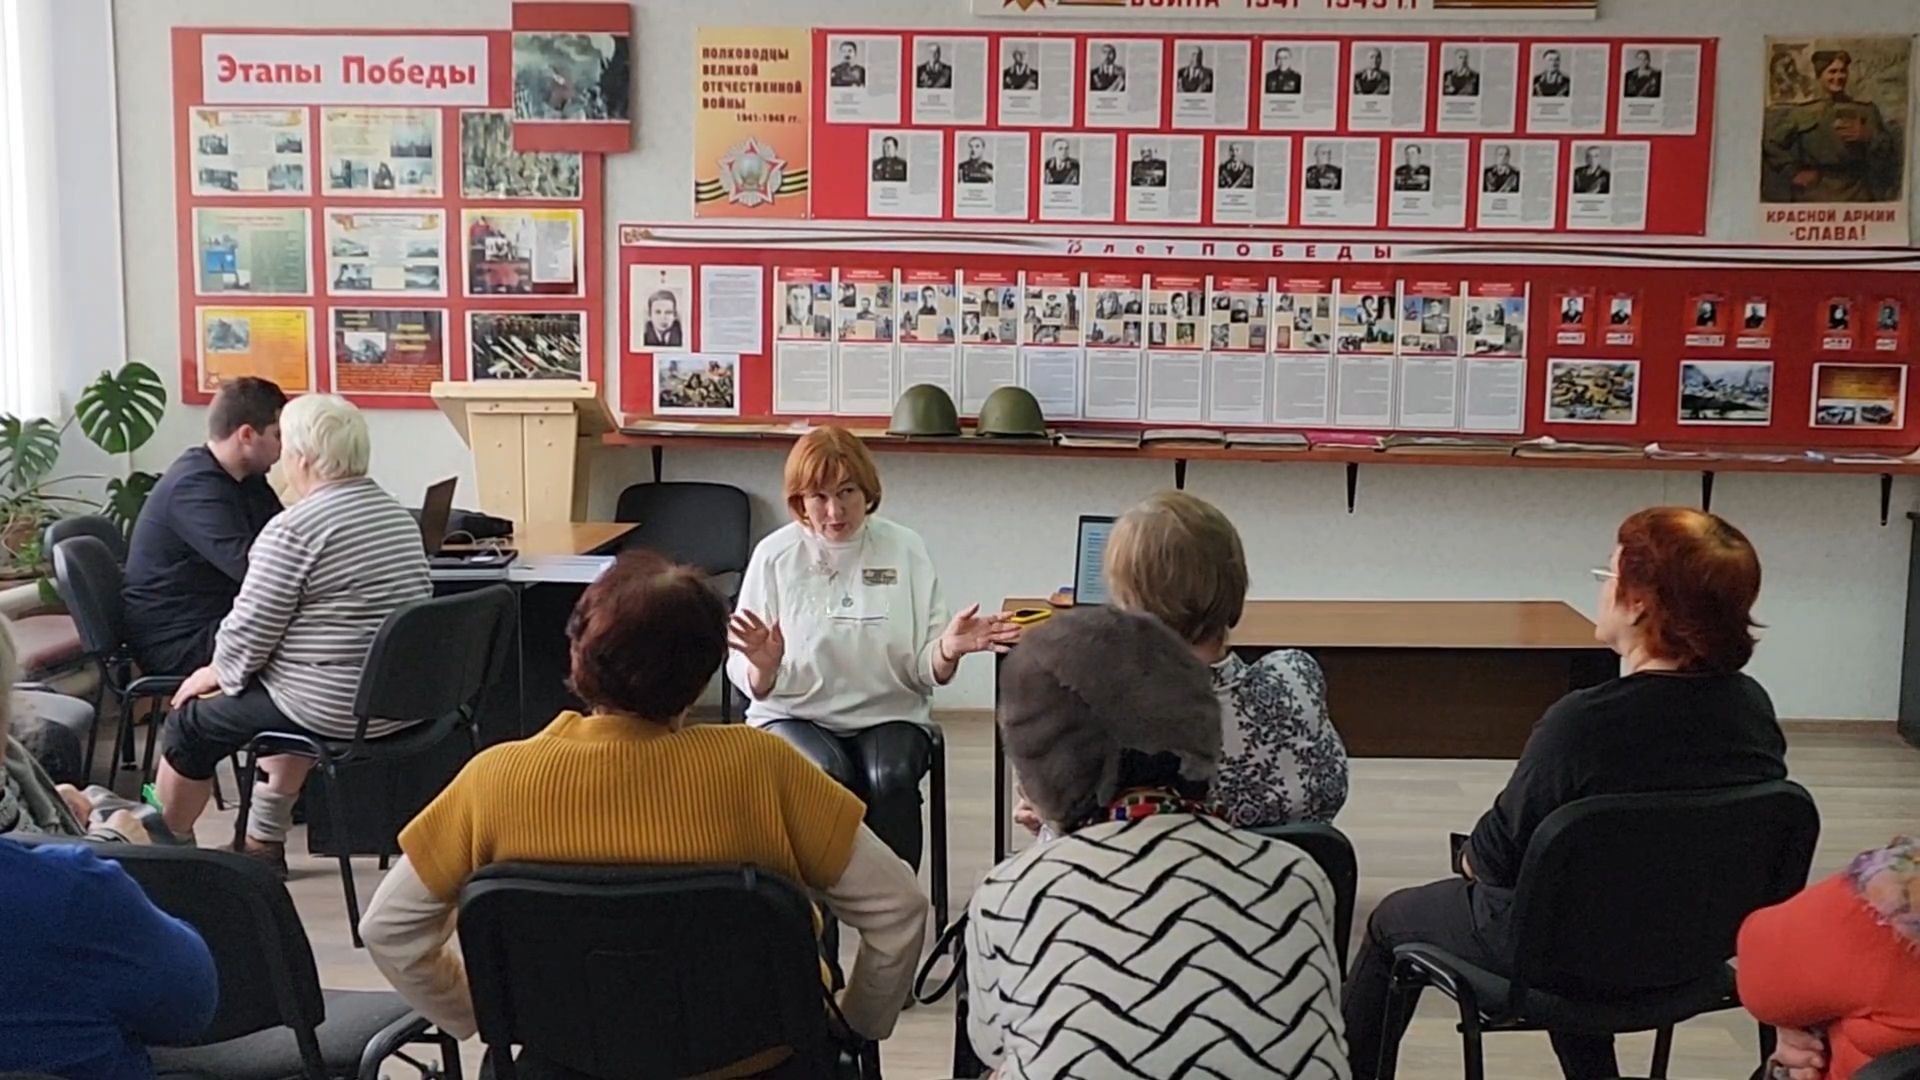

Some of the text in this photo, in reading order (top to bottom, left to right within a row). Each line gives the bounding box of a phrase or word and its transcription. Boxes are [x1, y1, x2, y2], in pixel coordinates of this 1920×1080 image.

[702, 47, 789, 61] ПОЛКОВОДЦЫ
[217, 54, 476, 89] Этапы Победы
[702, 63, 758, 76] ВЕЛИКОЙ
[702, 80, 803, 94] ОТЕЧЕСТВЕННОЙ
[702, 96, 746, 110] ВОЙНЫ
[1766, 209, 1896, 223] КРАСНОЙ АРМИИ
[1202, 242, 1392, 260] ПОБЕДЫ
